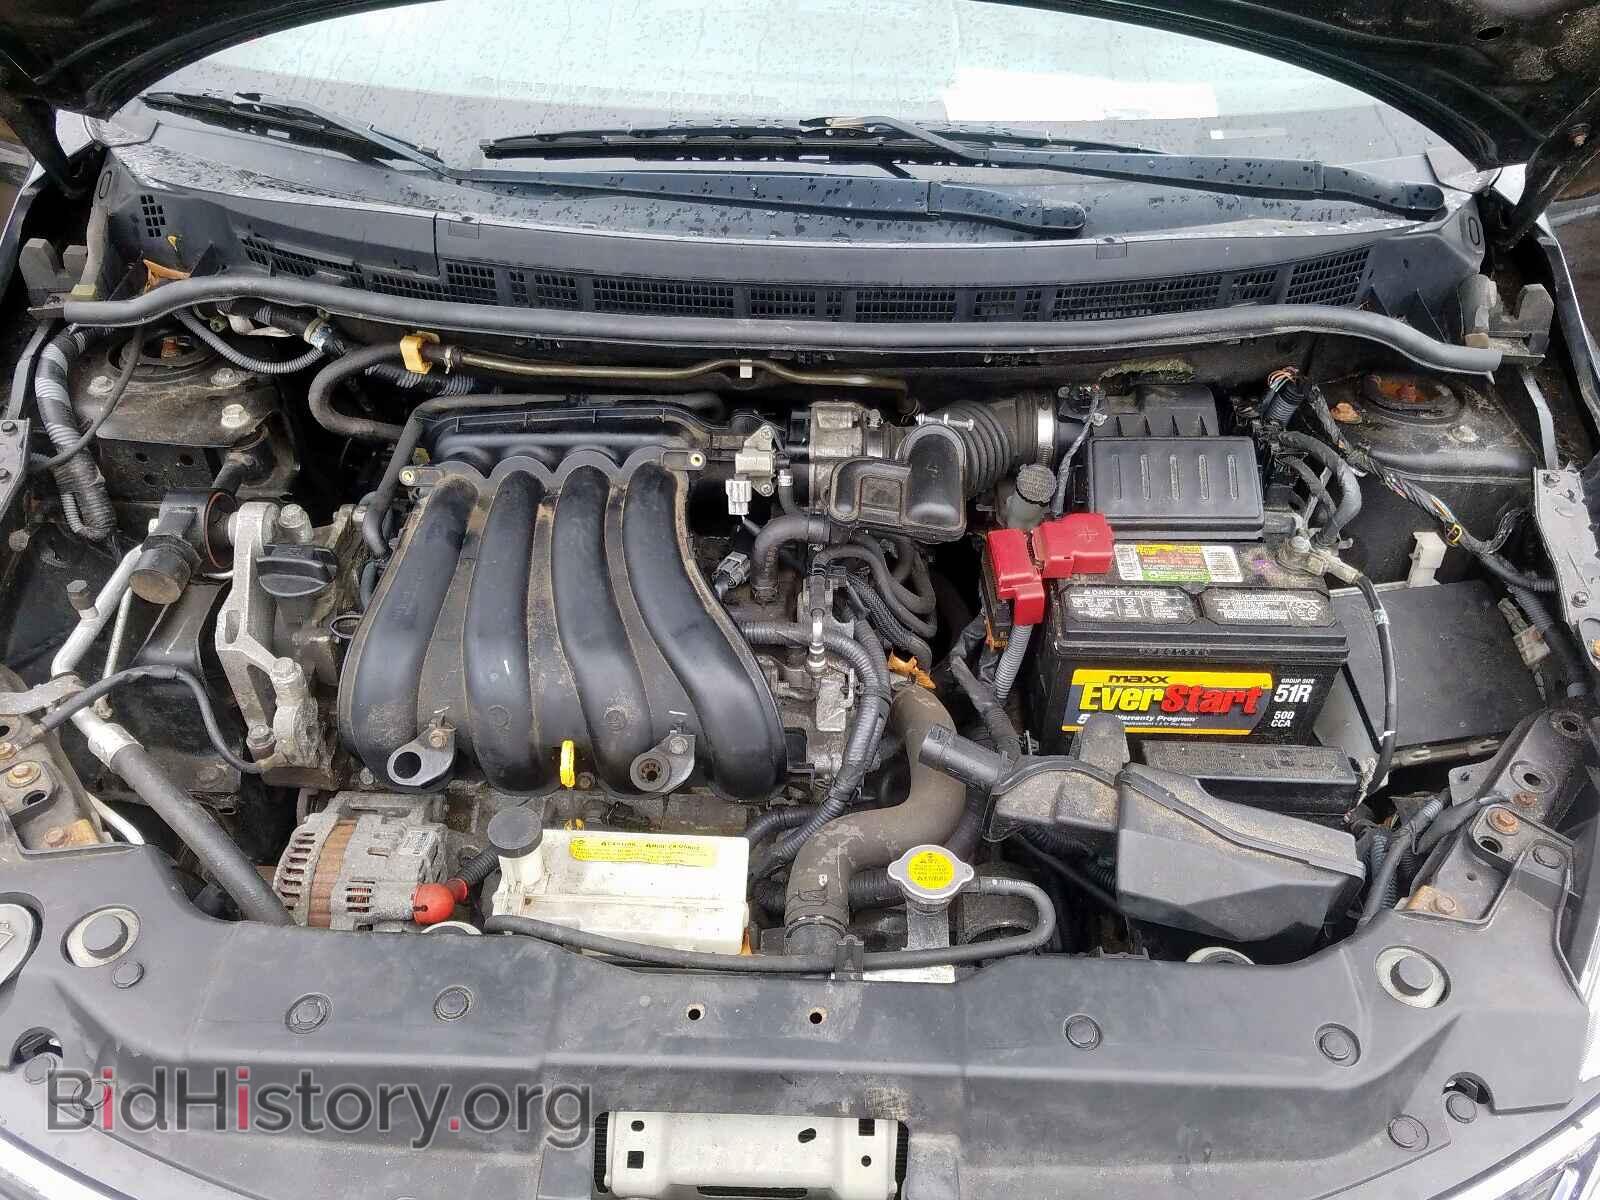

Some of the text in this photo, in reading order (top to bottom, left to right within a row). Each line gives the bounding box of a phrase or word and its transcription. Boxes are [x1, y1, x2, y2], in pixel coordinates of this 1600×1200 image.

[1109, 675, 1169, 683] maxx
[1079, 682, 1263, 714] EverStart
[1274, 684, 1313, 703] 51R
[1273, 711, 1295, 720] 500
[1270, 720, 1291, 728] CCA
